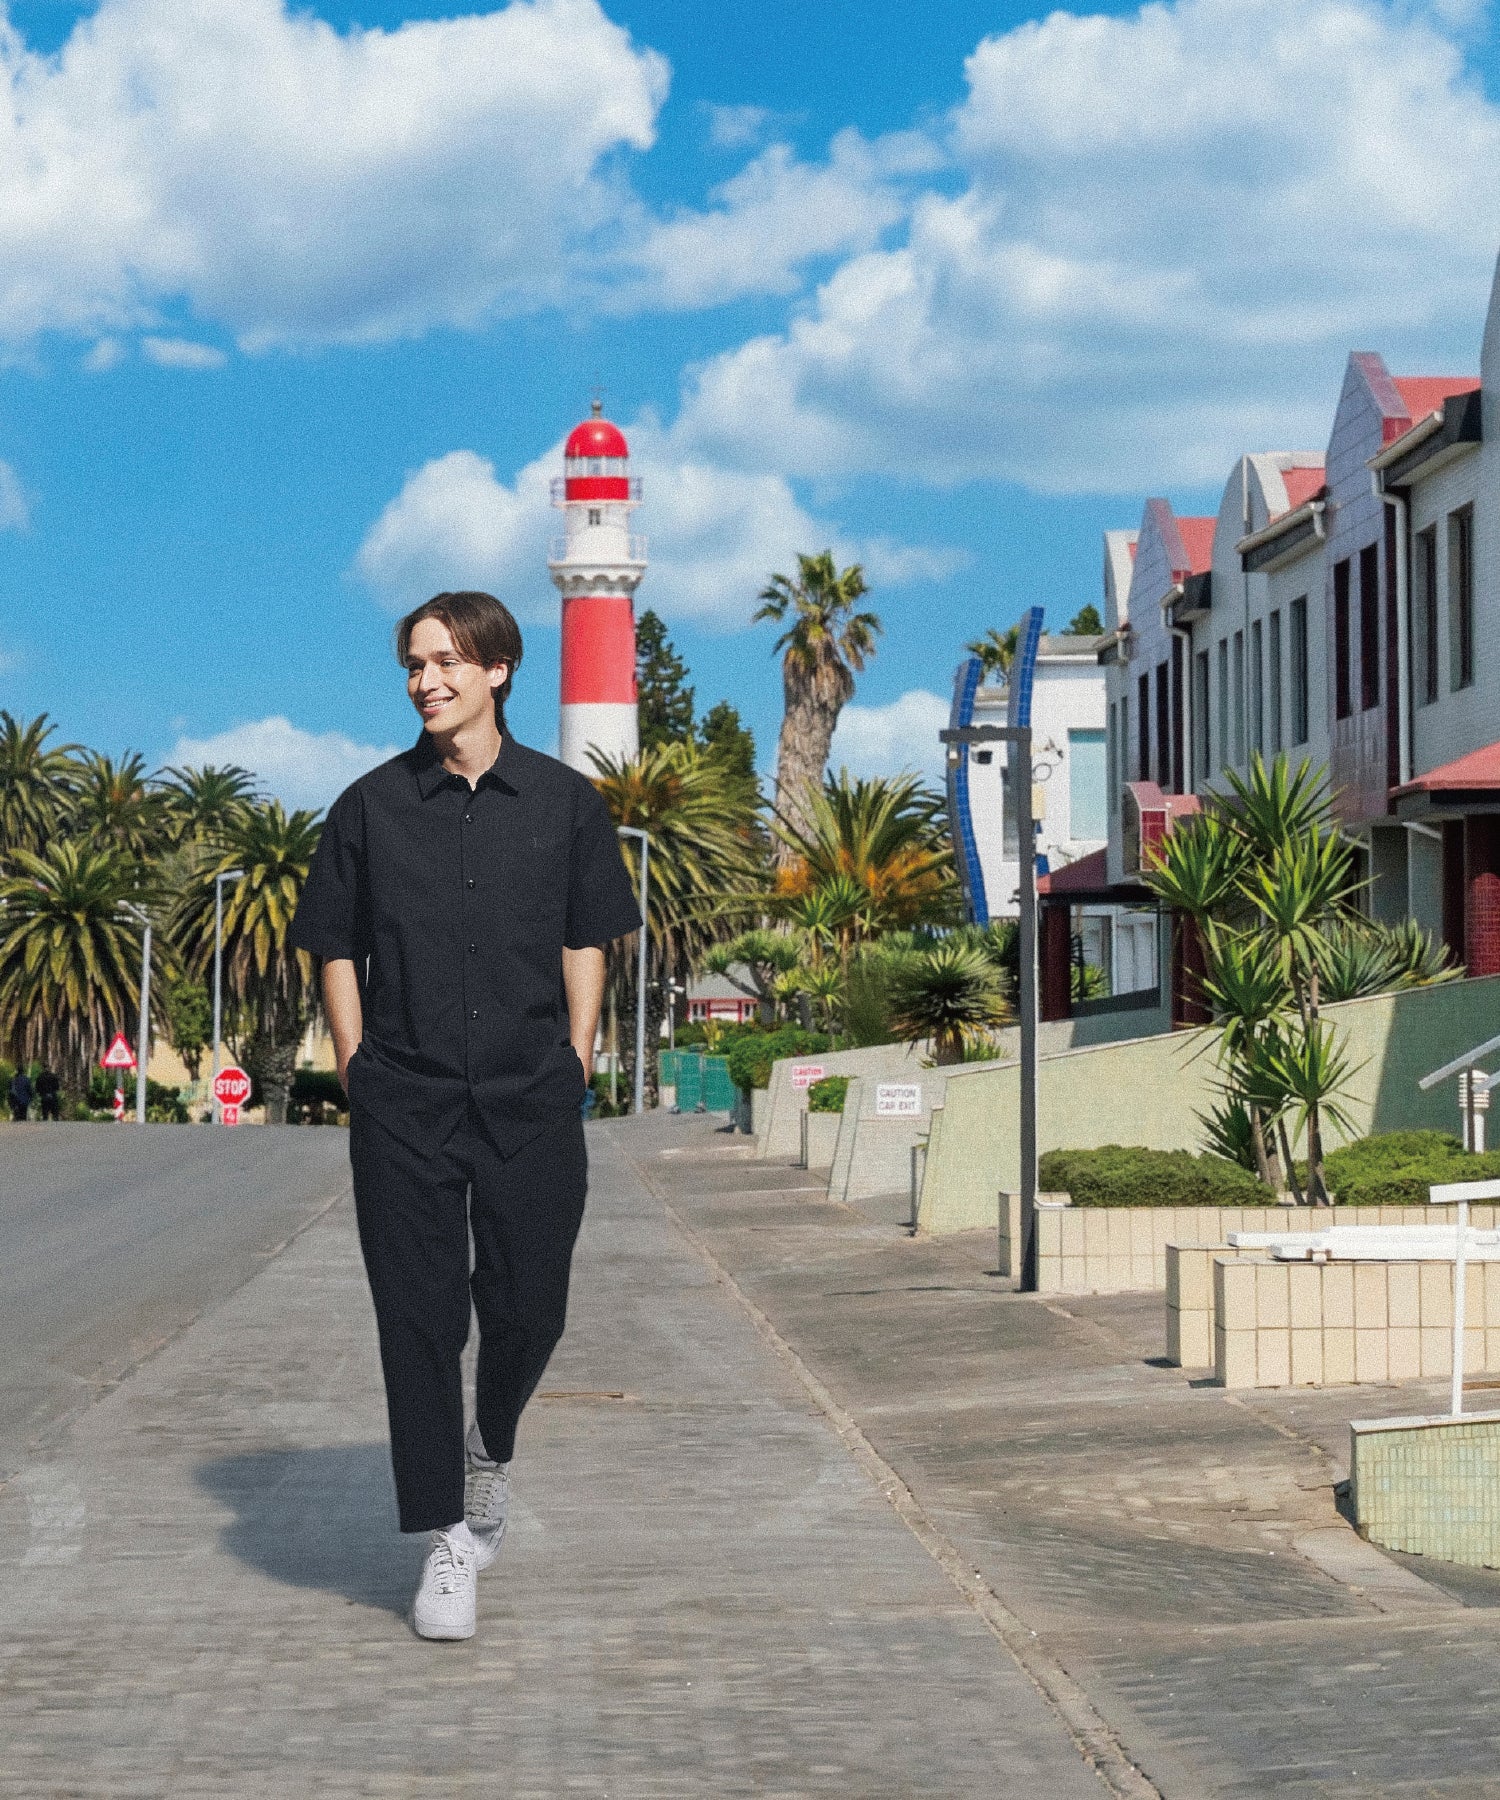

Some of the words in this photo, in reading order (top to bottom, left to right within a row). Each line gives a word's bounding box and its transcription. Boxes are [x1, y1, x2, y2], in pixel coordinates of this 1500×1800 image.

[216, 1079, 248, 1095] STOP
[880, 1089, 916, 1098] CAUTION
[880, 1101, 895, 1110] CAR
[899, 1101, 916, 1110] EXIT
